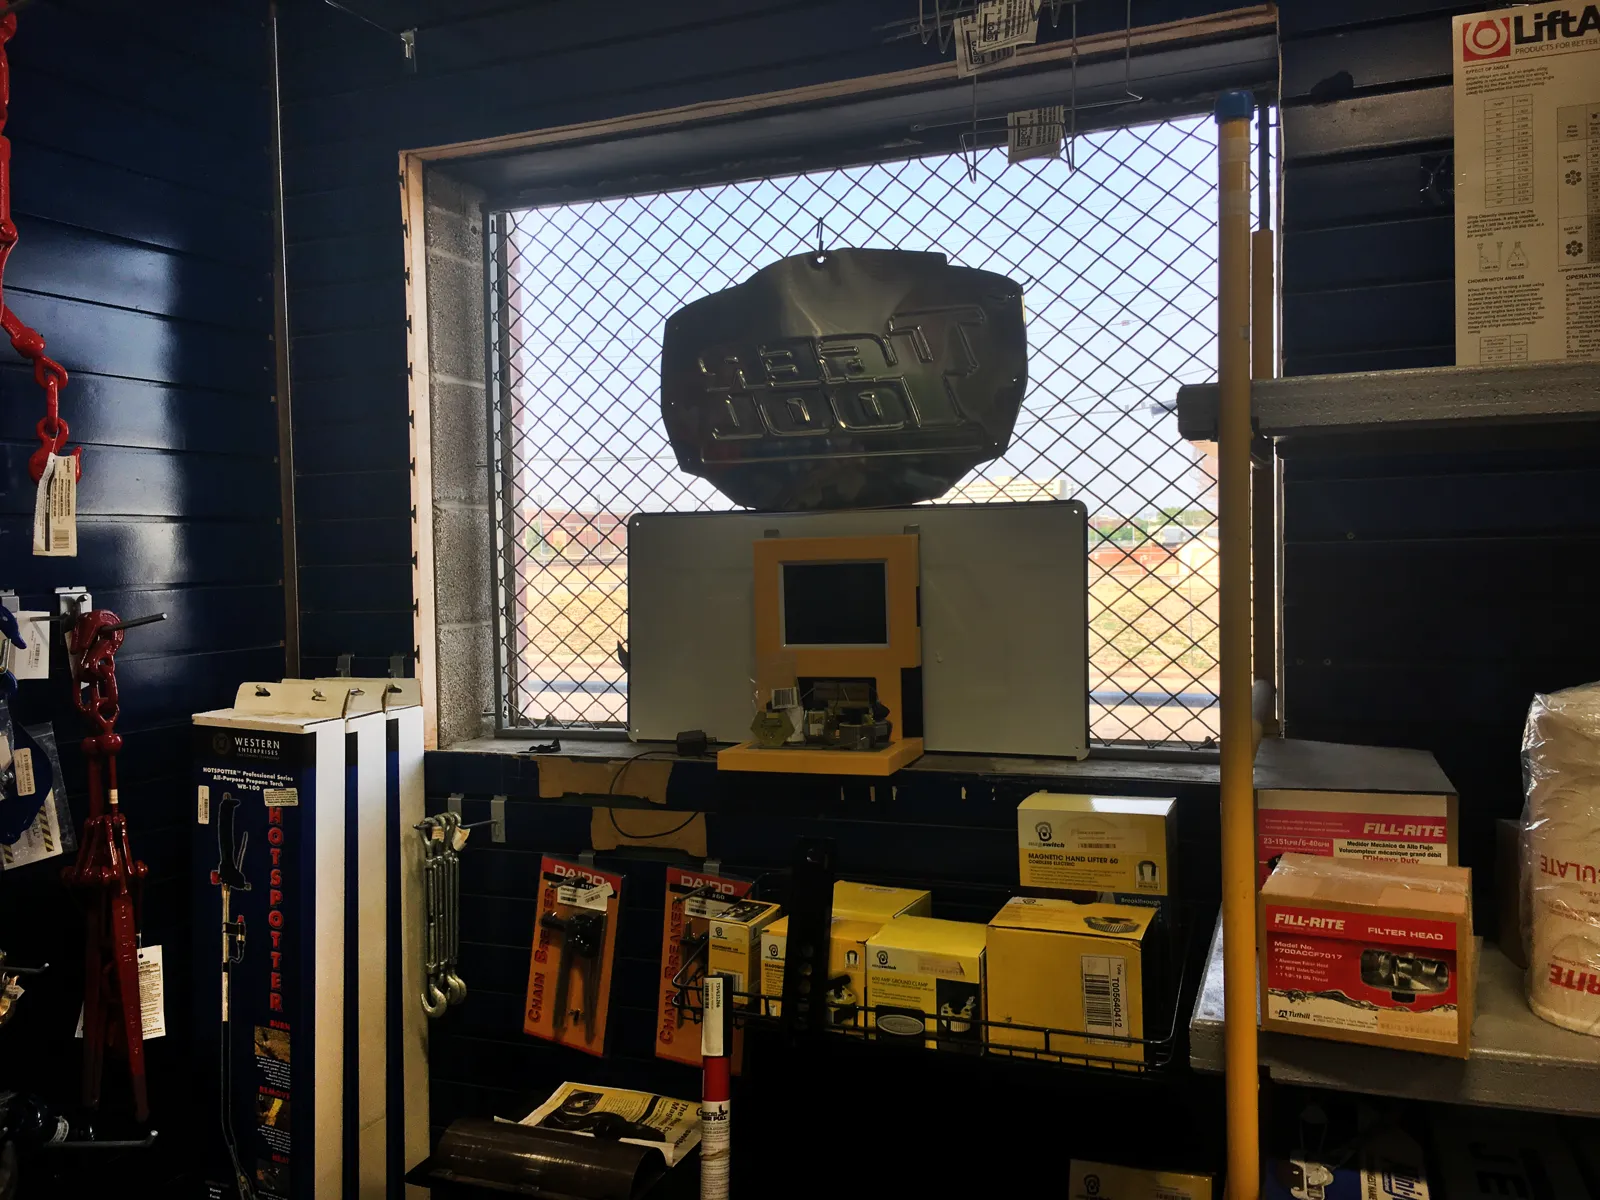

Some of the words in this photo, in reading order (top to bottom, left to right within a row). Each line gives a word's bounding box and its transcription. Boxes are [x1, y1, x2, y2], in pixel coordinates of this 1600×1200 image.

[1515, 43, 1554, 54] PRODUCTS
[1555, 41, 1571, 49] FOR
[1572, 38, 1597, 47] BETTER
[234, 737, 280, 749] WESTERN
[238, 747, 278, 756] ENTERPRISES
[213, 774, 244, 783] All-Purpose
[246, 778, 268, 786] Propane
[243, 771, 275, 780] Professional
[277, 774, 293, 782] Series
[237, 783, 260, 791] WB-100
[1363, 822, 1445, 837] FILL-RITE
[1028, 853, 1064, 861] MAGNETIC
[1066, 855, 1086, 863] HAND
[1409, 850, 1426, 858] grand
[554, 864, 605, 886] DAIDO
[1540, 854, 1600, 884] ULATE
[680, 875, 735, 896] DAIDO
[1120, 897, 1161, 906] Breakthrough
[1274, 913, 1346, 930] FILL-RITE
[1367, 927, 1406, 937] FILTER
[1410, 931, 1444, 941] HEAD
[1274, 941, 1298, 949] Model
[528, 972, 546, 1023] CHAIN
[1111, 978, 1122, 1028] T005640412
[1289, 1010, 1310, 1020] Tuthill
